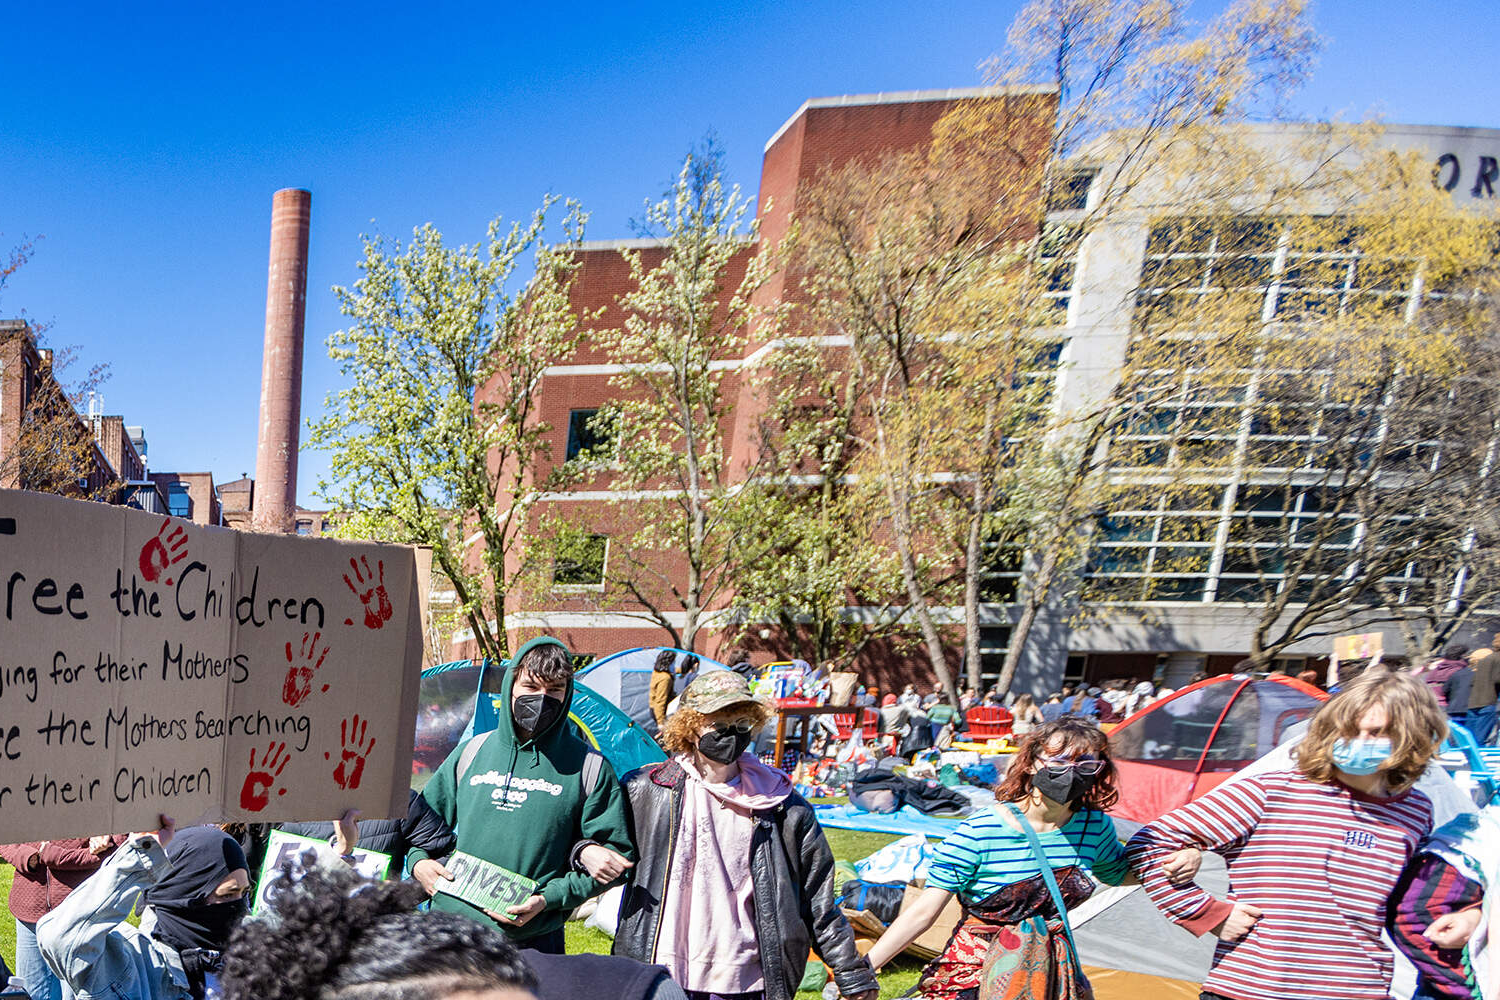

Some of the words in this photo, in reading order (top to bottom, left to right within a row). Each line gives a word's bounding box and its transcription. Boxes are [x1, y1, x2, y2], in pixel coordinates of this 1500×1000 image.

[111, 568, 162, 619] the
[176, 562, 325, 629] Children
[50, 651, 85, 684] for
[95, 651, 148, 682] their
[162, 640, 249, 684] Mothers
[38, 709, 93, 746] the
[105, 707, 187, 752] Mothers
[25, 773, 101, 804] their
[114, 766, 211, 803] Children
[450, 857, 536, 906] DIVEST
